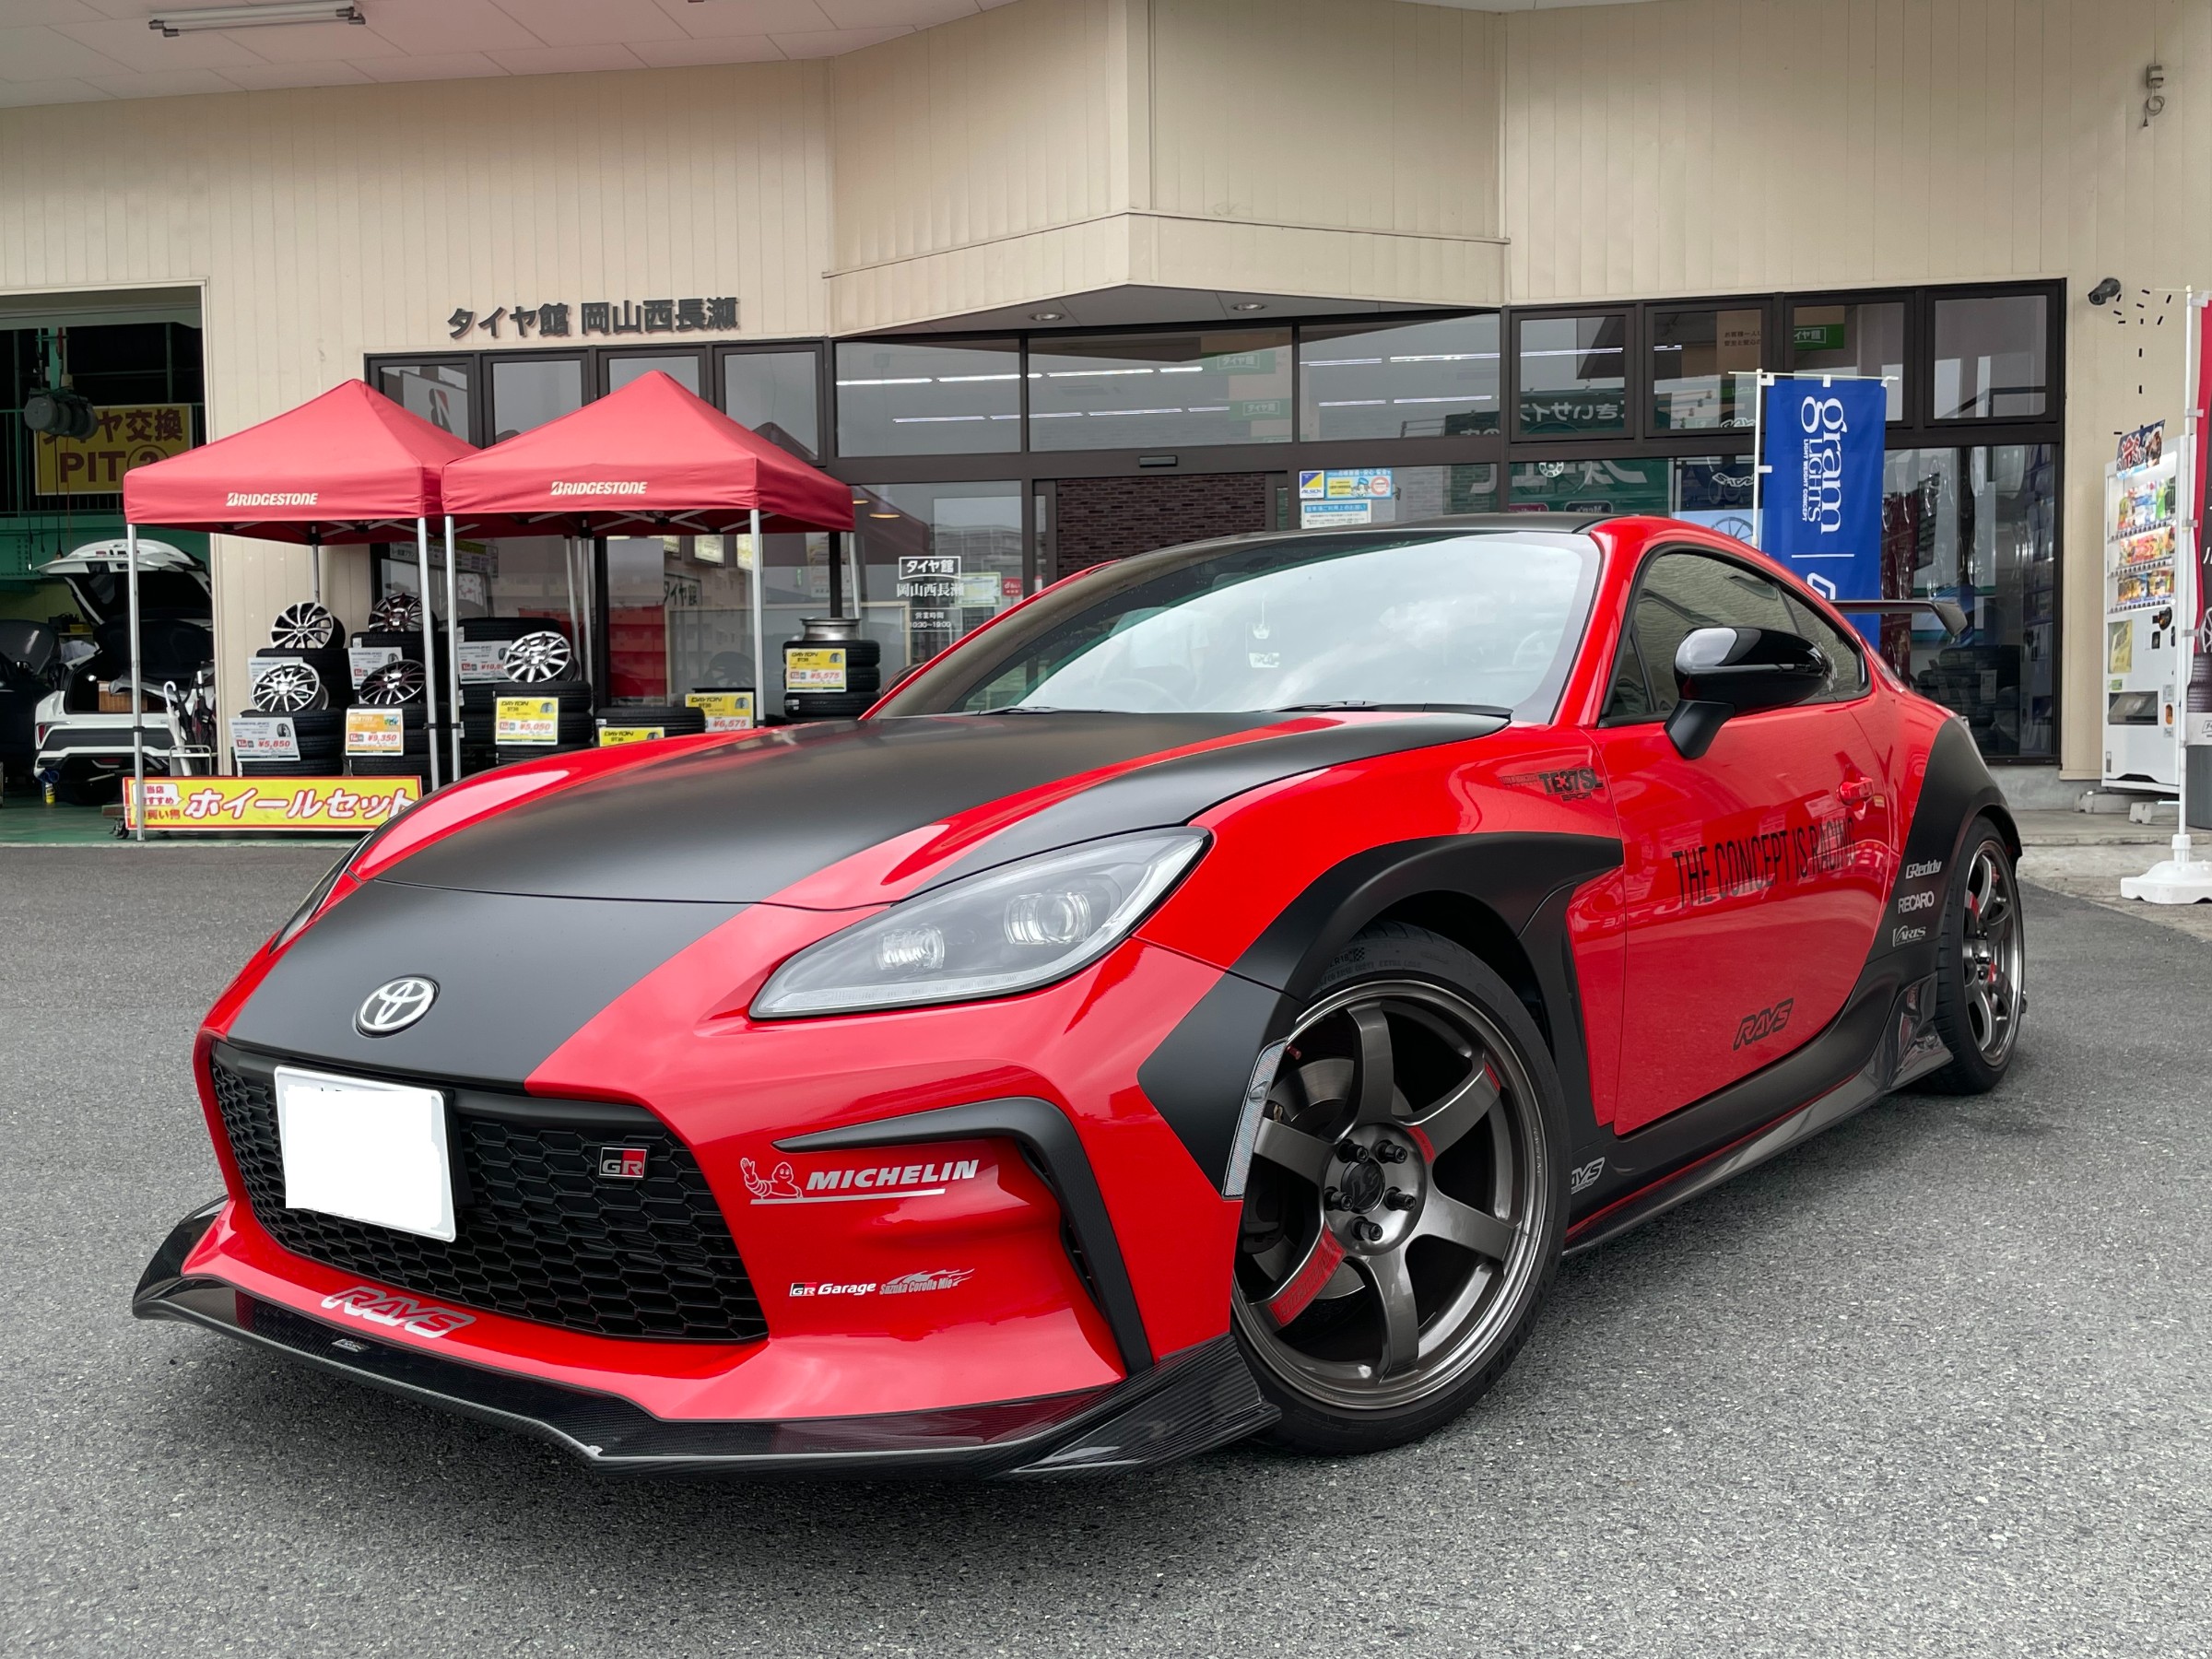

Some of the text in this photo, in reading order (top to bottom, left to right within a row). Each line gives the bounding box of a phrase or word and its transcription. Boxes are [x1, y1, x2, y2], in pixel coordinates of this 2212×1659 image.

[448, 296, 740, 339] タイヤ館 岡山西長瀬
[1801, 395, 1848, 535] gram
[550, 480, 649, 496] BRIDGESTONE
[1807, 438, 1823, 523] LIGHTS
[225, 492, 319, 507] BRIDGESTONE
[906, 559, 955, 573] タイヤ館
[896, 582, 965, 598] 岡山西長瀬
[1538, 767, 1604, 795] TE37SL
[143, 809, 181, 819] 買い得
[183, 786, 416, 819] ホイールセット
[1671, 817, 1857, 909] THE CONCEPT IS RACING
[1898, 890, 1935, 913] RECARO
[1733, 997, 1794, 1051] RAYS
[806, 1159, 980, 1191] MICHELIN
[791, 1277, 953, 1297] GR Garage Suzuka Corolla Mie
[321, 1286, 477, 1339] RAYS
